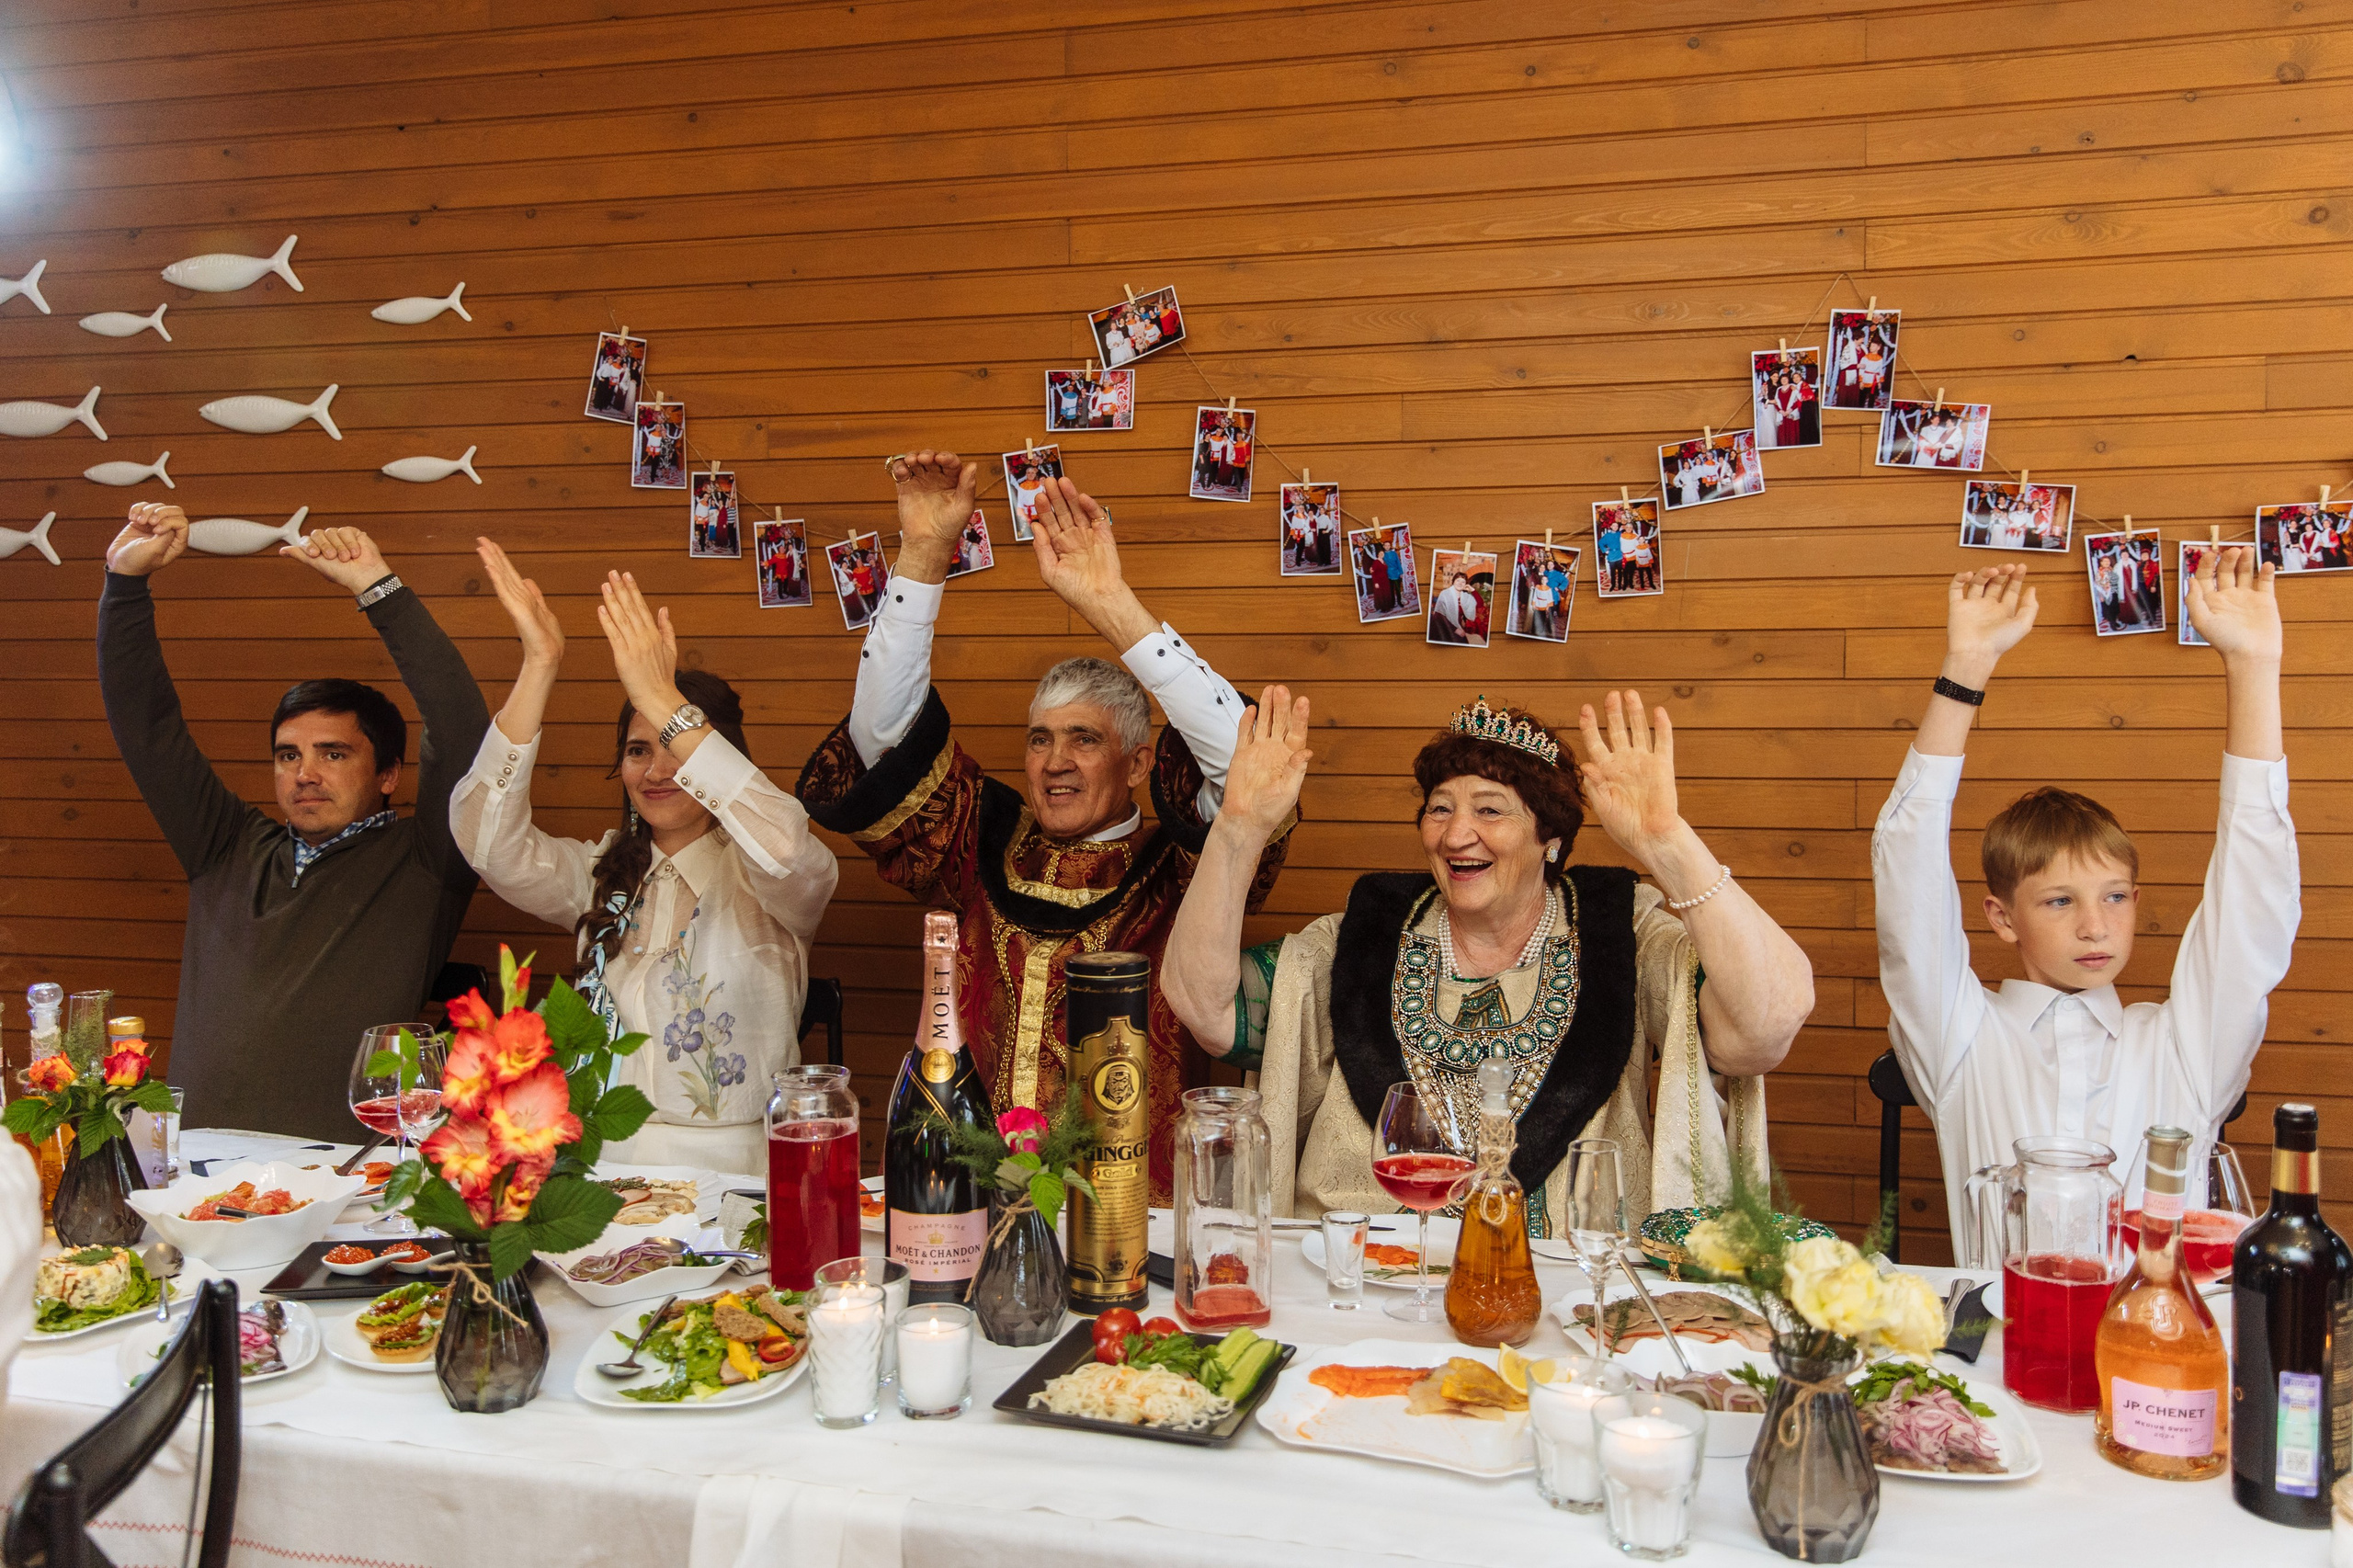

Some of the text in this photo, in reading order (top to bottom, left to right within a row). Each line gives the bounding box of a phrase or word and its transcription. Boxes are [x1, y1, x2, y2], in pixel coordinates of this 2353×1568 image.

[931, 967, 950, 1040] MOËT
[1073, 1140, 1147, 1162] HINGGI
[1102, 1165, 1133, 1178] Gold
[907, 1223, 966, 1232] CHAMPAGNE
[929, 1244, 981, 1258] CHANDON
[928, 1257, 972, 1266] IMPÉRIAL
[2122, 1400, 2206, 1419] JP. CHENET
